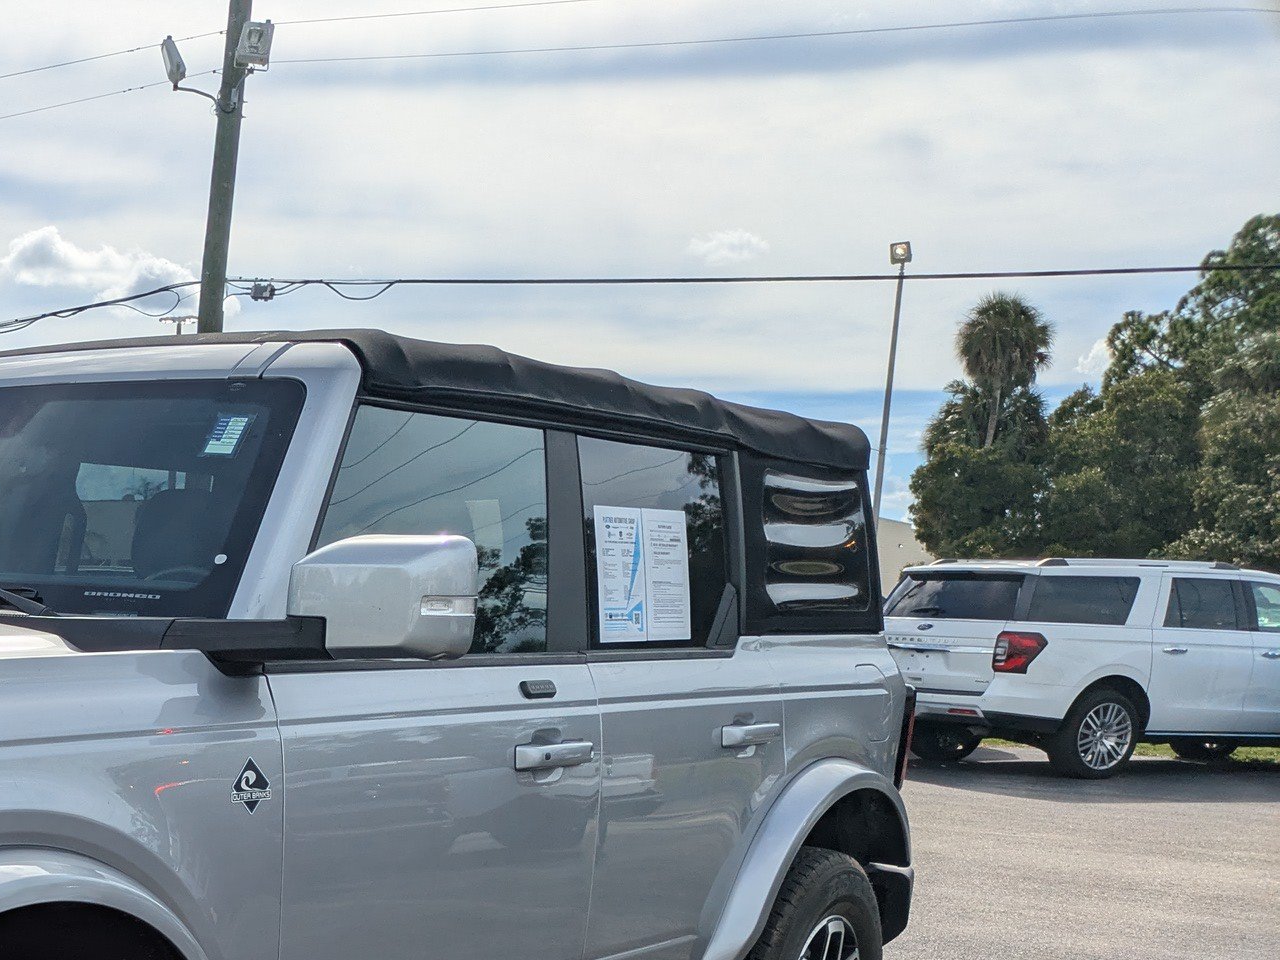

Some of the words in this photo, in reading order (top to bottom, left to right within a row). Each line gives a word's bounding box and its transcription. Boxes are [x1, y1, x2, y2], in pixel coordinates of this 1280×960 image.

[84, 591, 161, 600] BRONCO
[233, 793, 252, 801] OUTER
[251, 791, 270, 800] BANKS
